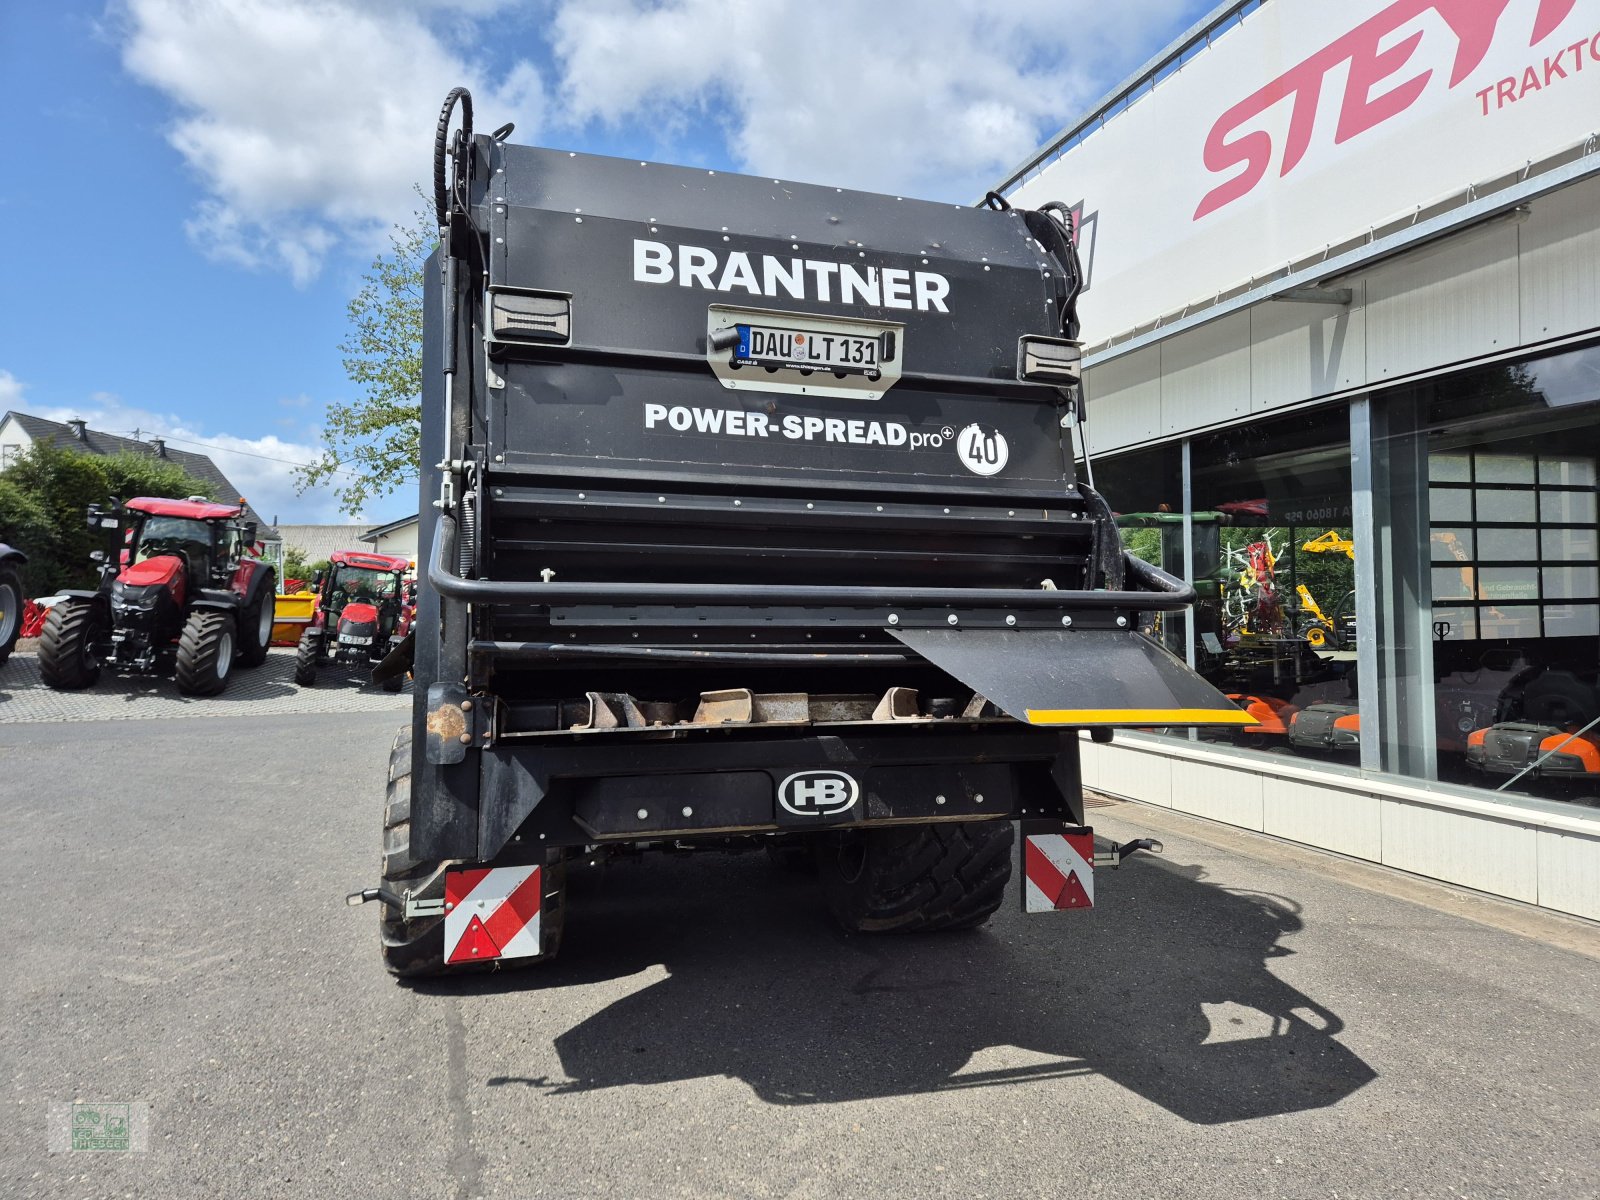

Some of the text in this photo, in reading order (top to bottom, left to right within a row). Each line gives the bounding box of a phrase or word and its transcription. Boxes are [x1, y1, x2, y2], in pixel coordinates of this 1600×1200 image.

[1193, 0, 1577, 221] STEY
[633, 238, 951, 314] BRANTNER
[751, 331, 877, 365] DAU LT 131
[645, 402, 908, 447] POWER-SPREAD
[794, 778, 847, 806] HB
